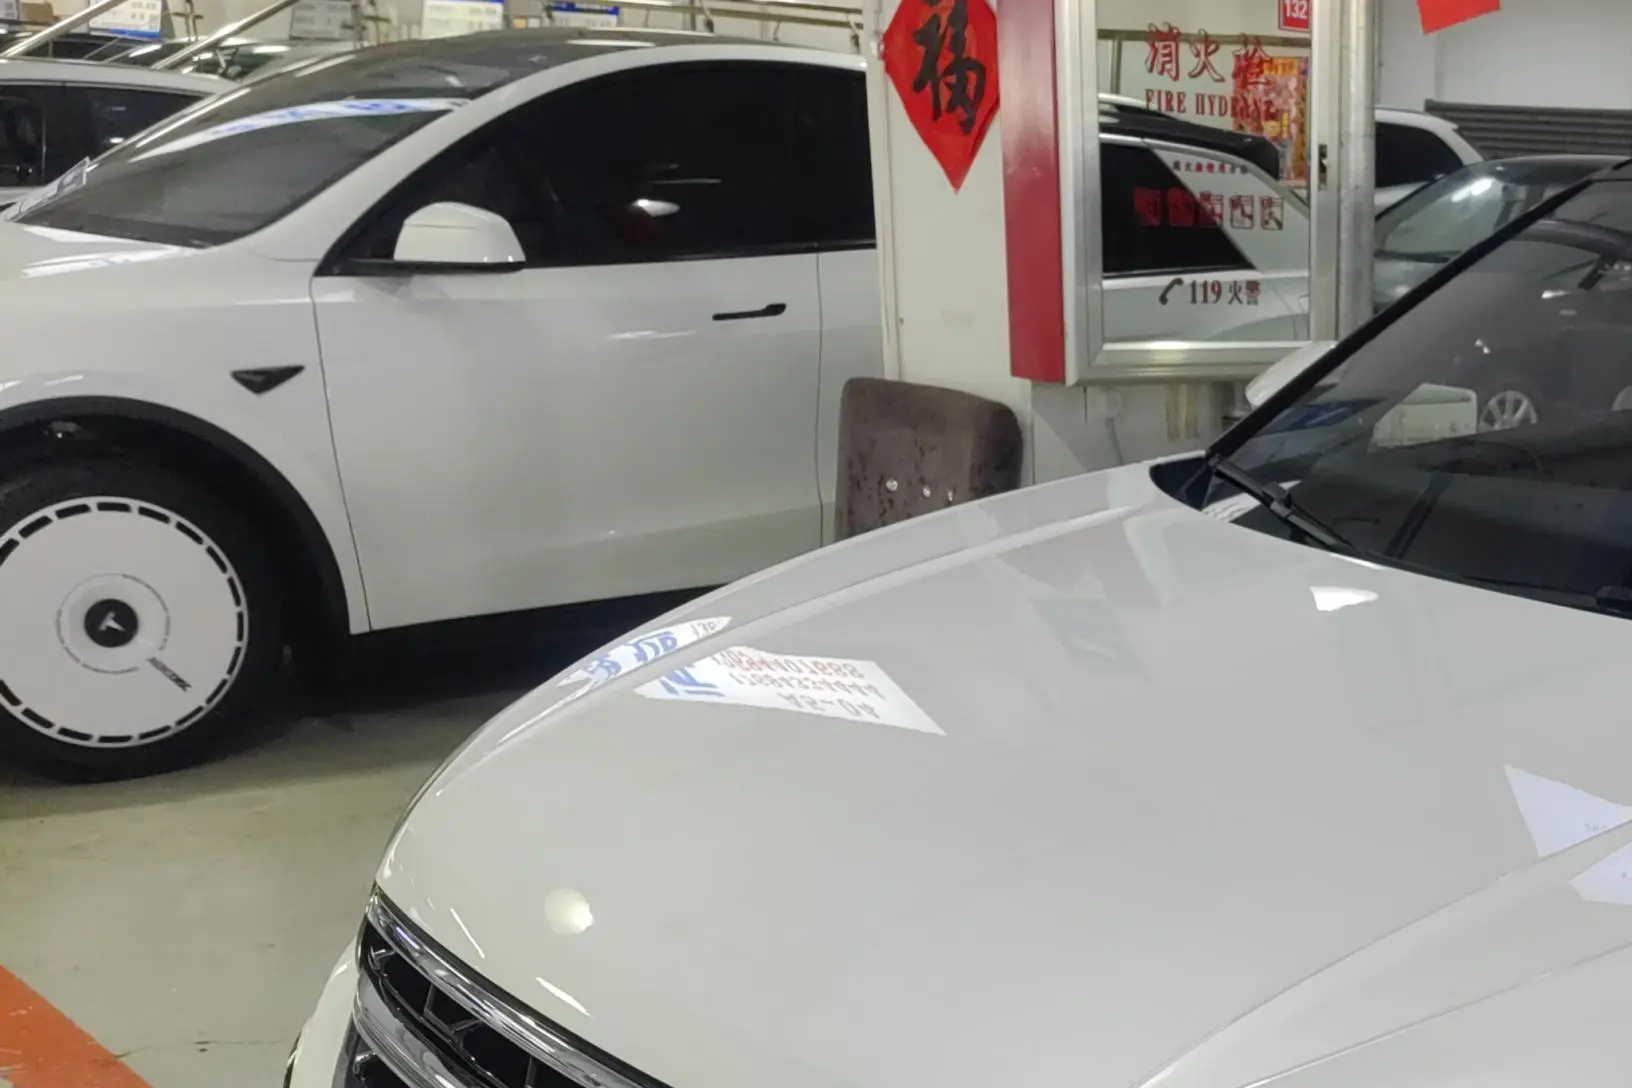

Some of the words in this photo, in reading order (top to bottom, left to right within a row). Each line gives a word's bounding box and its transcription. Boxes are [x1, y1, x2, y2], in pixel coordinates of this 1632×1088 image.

[1284, 0, 1308, 19] 132
[1144, 22, 1273, 90] 消火栓
[1145, 88, 1187, 114] FIRE
[1190, 280, 1222, 305] 119
[1228, 280, 1261, 306] 火警
